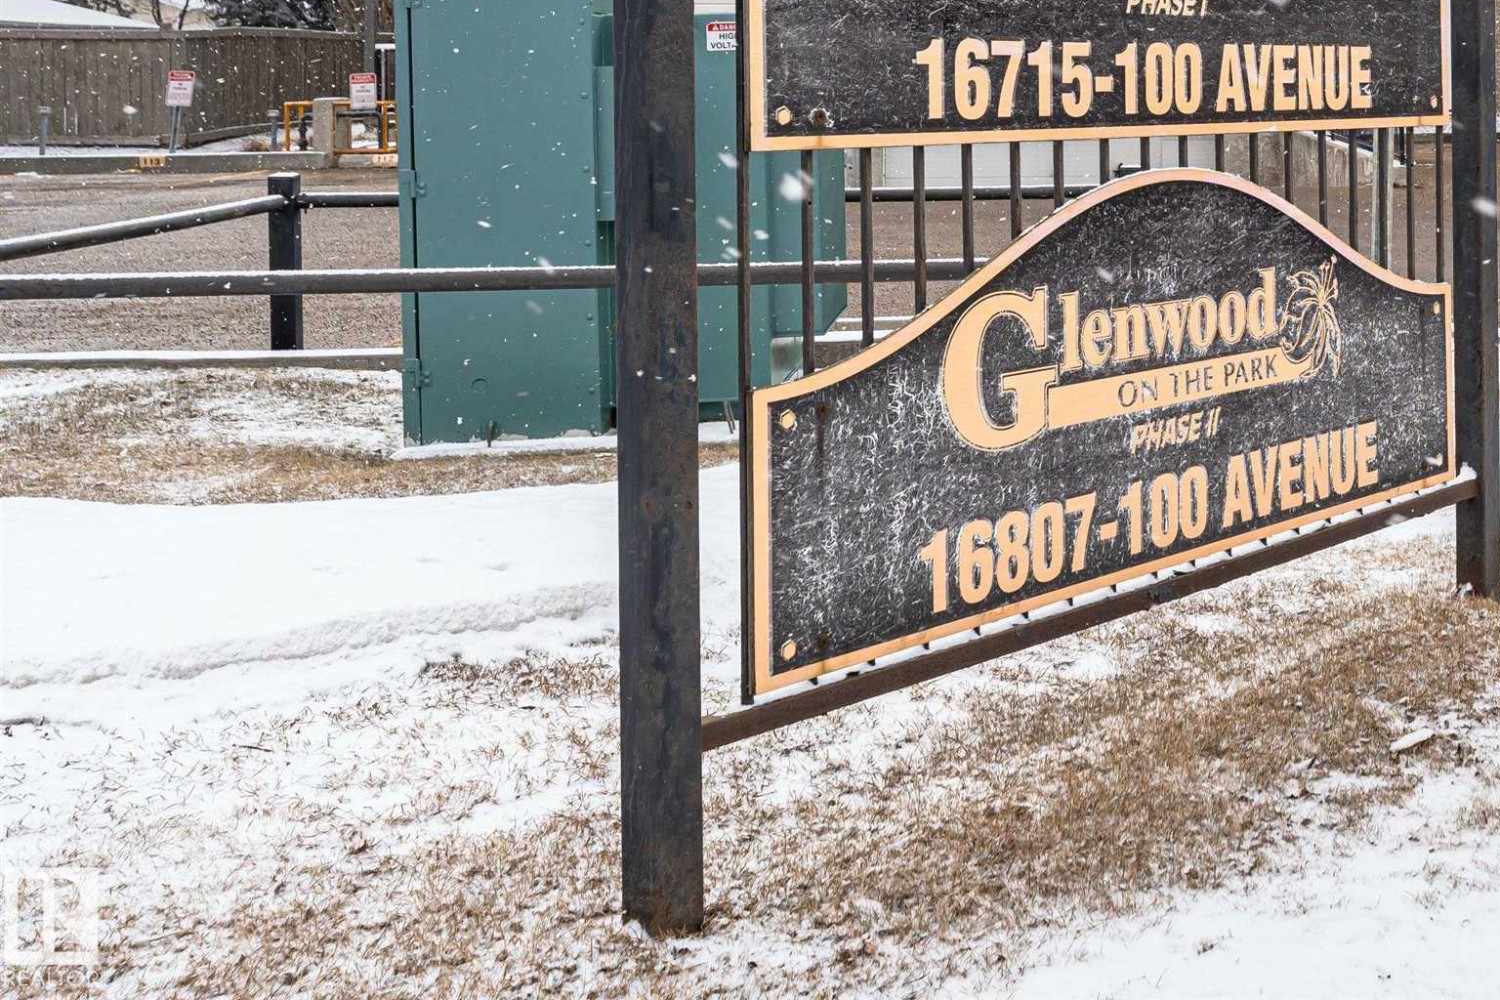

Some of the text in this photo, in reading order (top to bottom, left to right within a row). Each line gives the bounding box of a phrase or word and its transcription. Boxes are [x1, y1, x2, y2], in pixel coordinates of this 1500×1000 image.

[913, 37, 1373, 120] 16715-100 AVENUE
[942, 267, 1278, 452] Glenwood
[1118, 354, 1278, 407] ON THE PARK
[1131, 406, 1222, 453] PHASE II
[919, 420, 1379, 613] 16807-100 AVENUE
